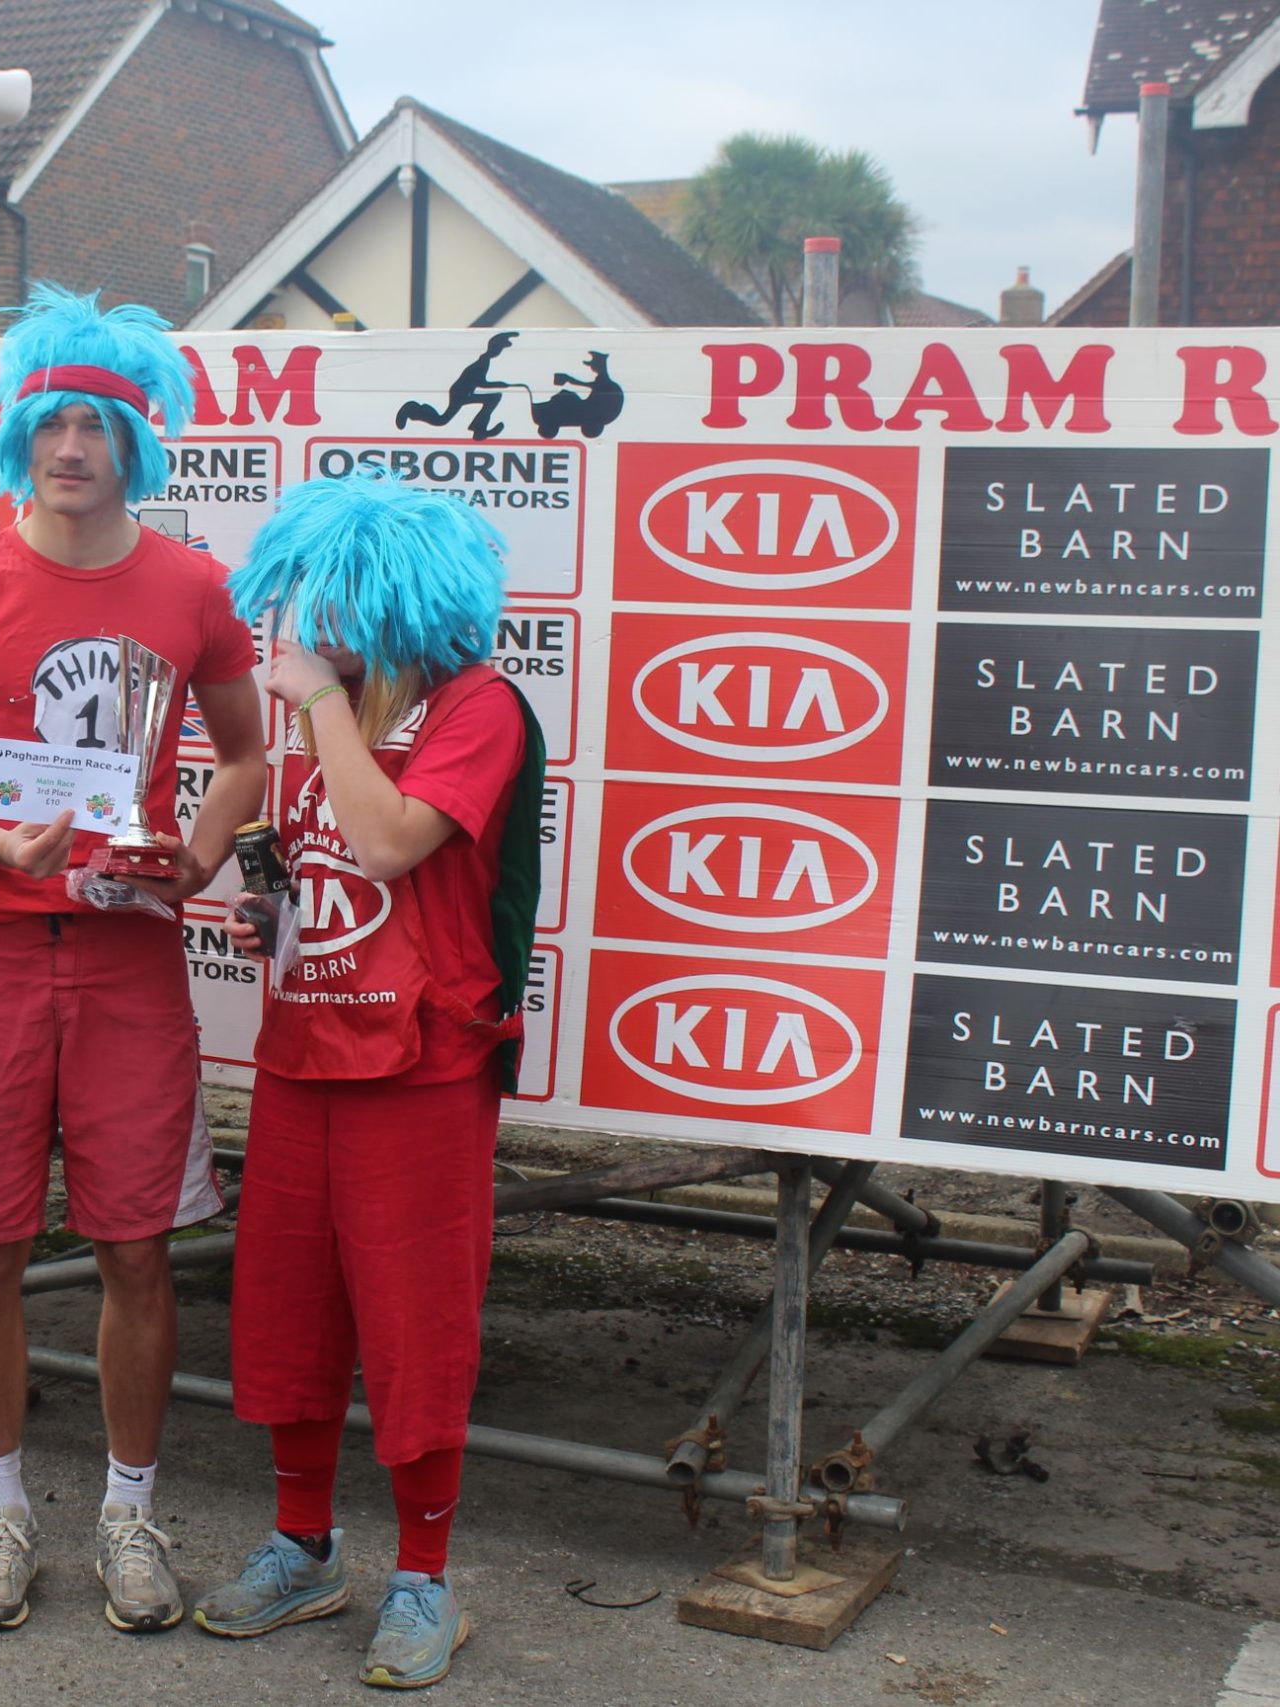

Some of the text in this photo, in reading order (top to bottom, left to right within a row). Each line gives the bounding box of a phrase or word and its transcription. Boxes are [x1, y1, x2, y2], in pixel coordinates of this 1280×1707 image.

[701, 342, 1115, 433] PRAM
[986, 482, 1229, 514] SLATED
[685, 490, 855, 558] KIA
[1020, 529, 1190, 561] BARN
[956, 579, 1256, 598] www.newbarncars.com
[35, 650, 121, 701] THIN
[977, 658, 1219, 696] SLATED
[677, 662, 846, 732] KIA
[75, 694, 107, 749] 1
[1010, 706, 1179, 742] BARN
[4, 750, 50, 765] Pagham
[53, 755, 82, 767] Pram
[86, 759, 112, 771] Race
[946, 755, 1246, 780] www.newbarncars.com
[36, 777, 76, 789] Main Race
[36, 786, 73, 798] 3rd Place
[304, 831, 330, 849] RAM
[965, 835, 1207, 877] SLATED
[668, 831, 834, 905] KIA
[300, 878, 357, 929] IA
[998, 883, 1167, 923] BARN
[303, 952, 358, 981] BARN
[933, 930, 1233, 964] www.newbarncars.com
[654, 1001, 818, 1079] KIA
[952, 1012, 1195, 1062] SLATED
[985, 1061, 1155, 1106] BARN
[919, 1107, 1221, 1149] www.newbarncars.com
